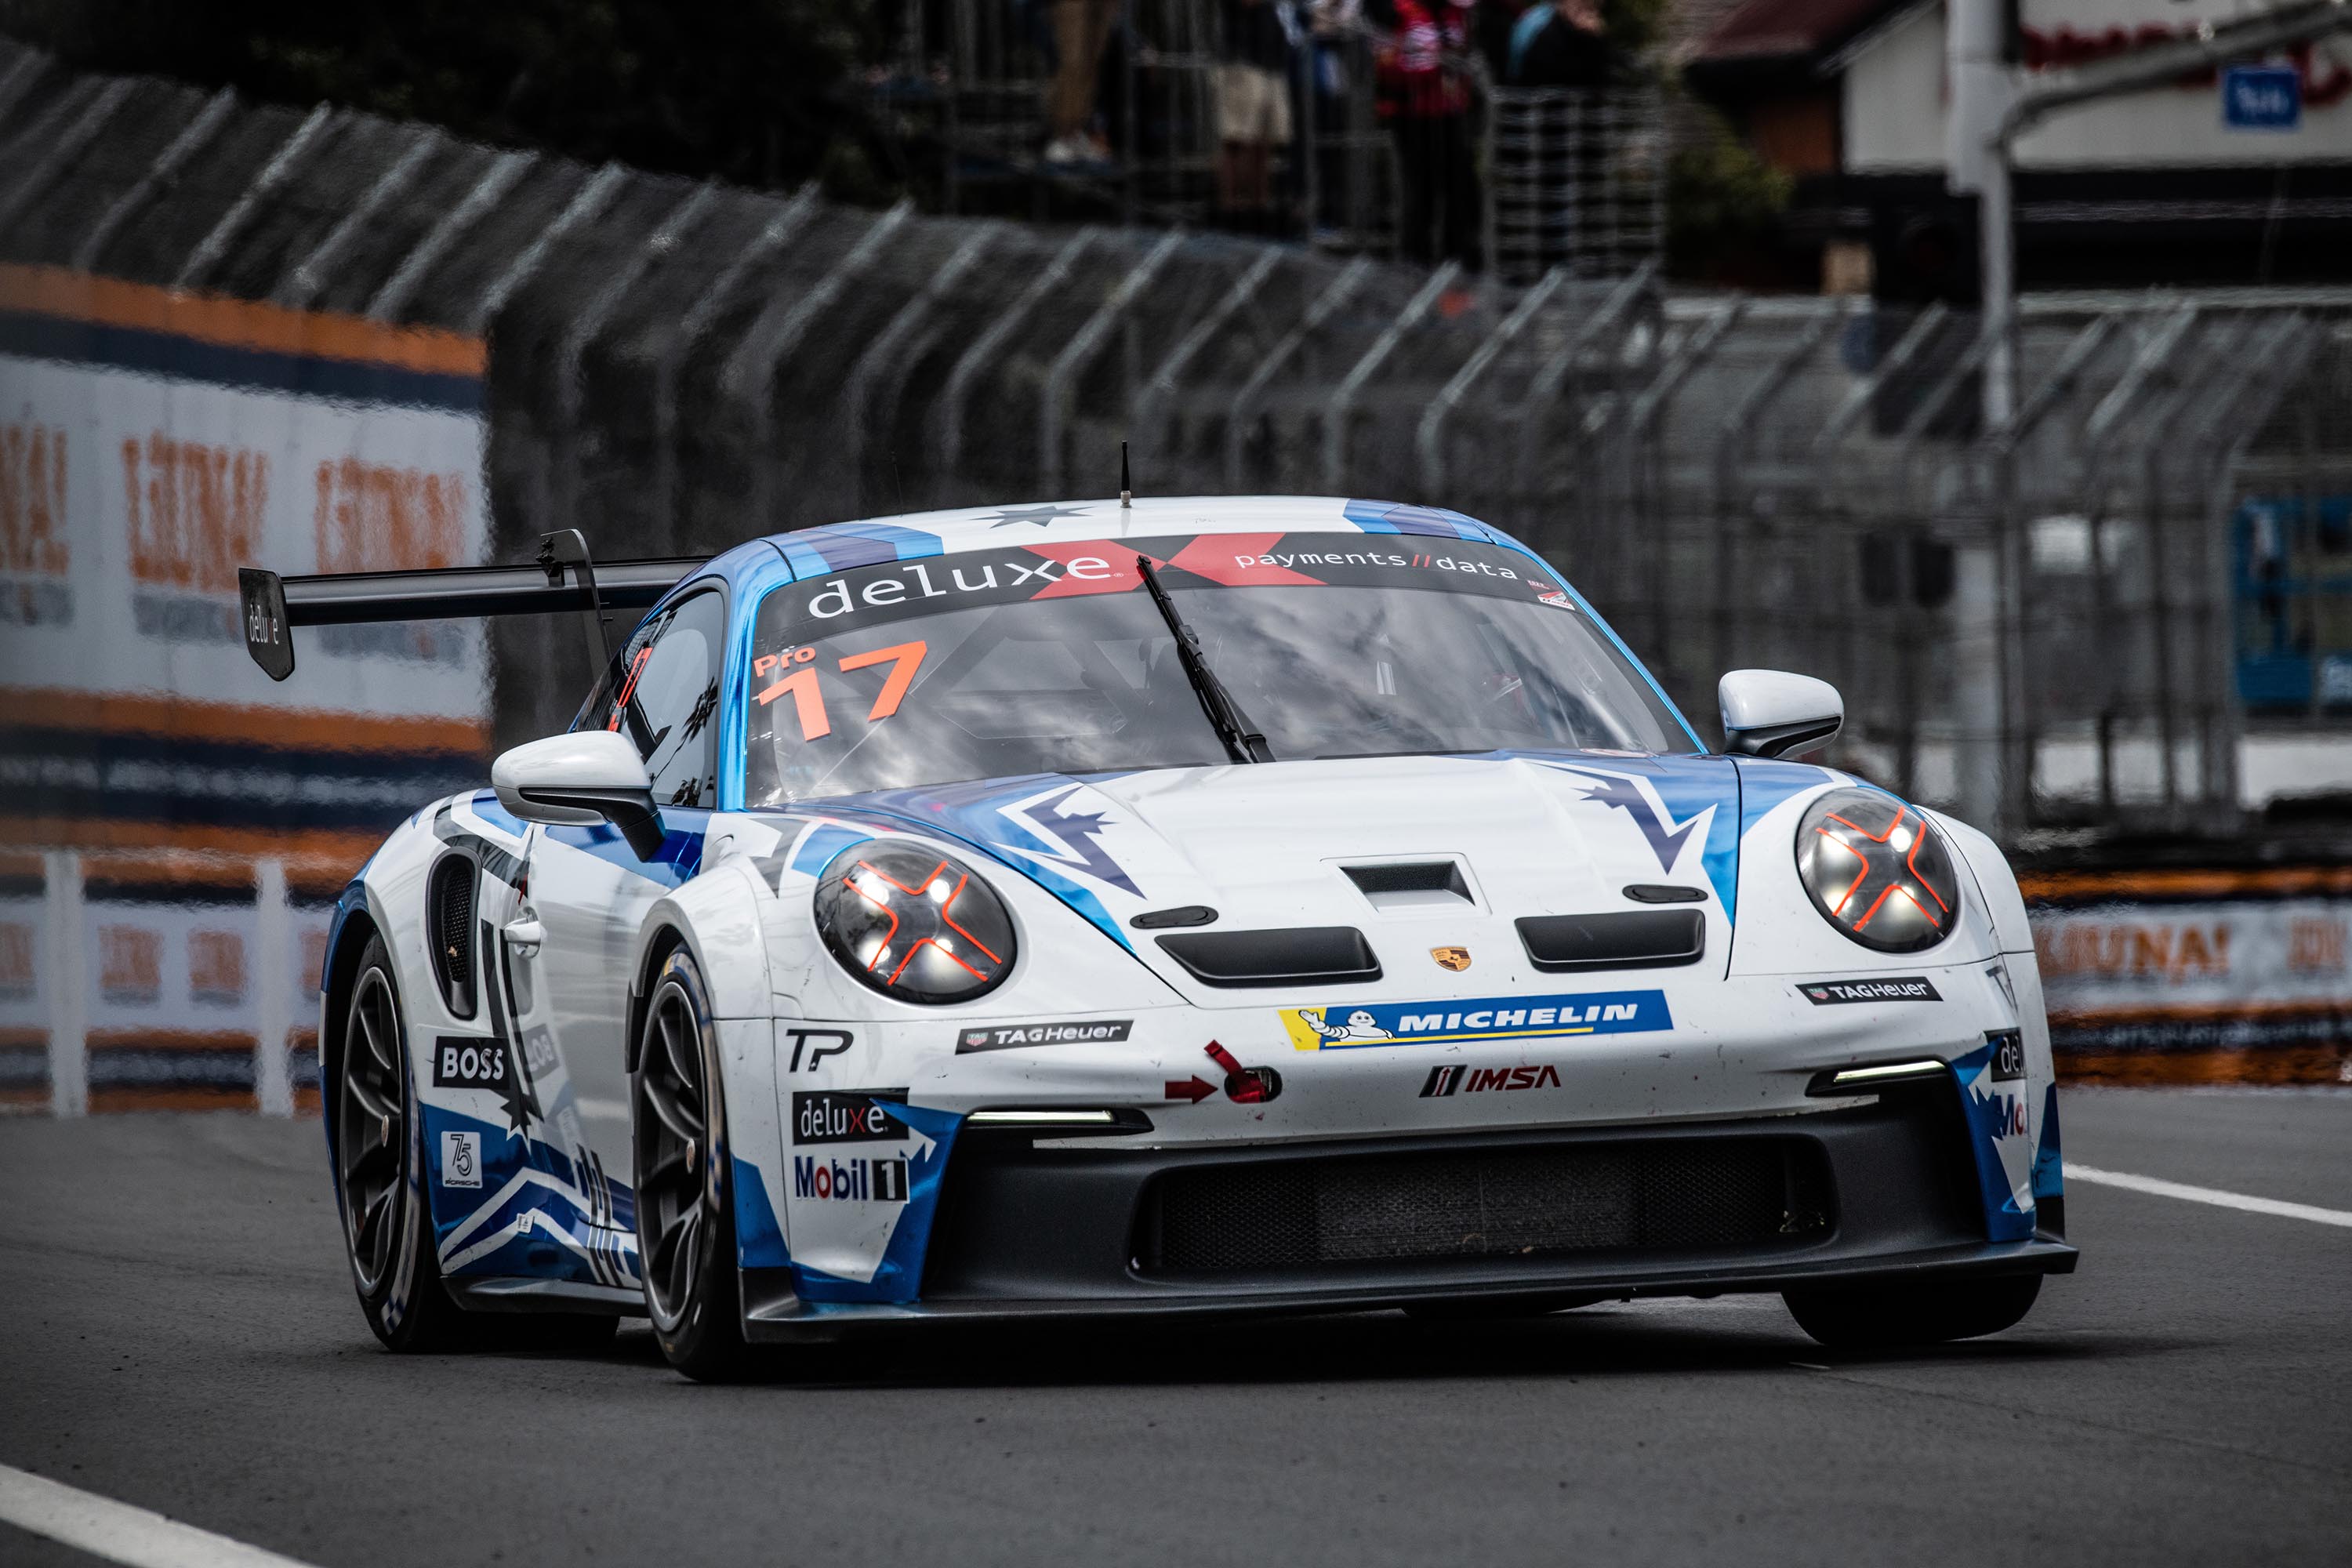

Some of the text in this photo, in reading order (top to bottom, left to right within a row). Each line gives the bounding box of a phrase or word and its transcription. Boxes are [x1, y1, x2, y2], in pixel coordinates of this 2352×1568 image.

[753, 646, 817, 678] Pro
[758, 640, 928, 742] 17
[1398, 1004, 1639, 1033] MICHELIN
[442, 1047, 504, 1080] BOSS
[786, 1029, 855, 1073] TP
[1465, 1065, 1562, 1092] IMSA
[450, 1134, 473, 1177] 75
[794, 1155, 869, 1202] Mobil
